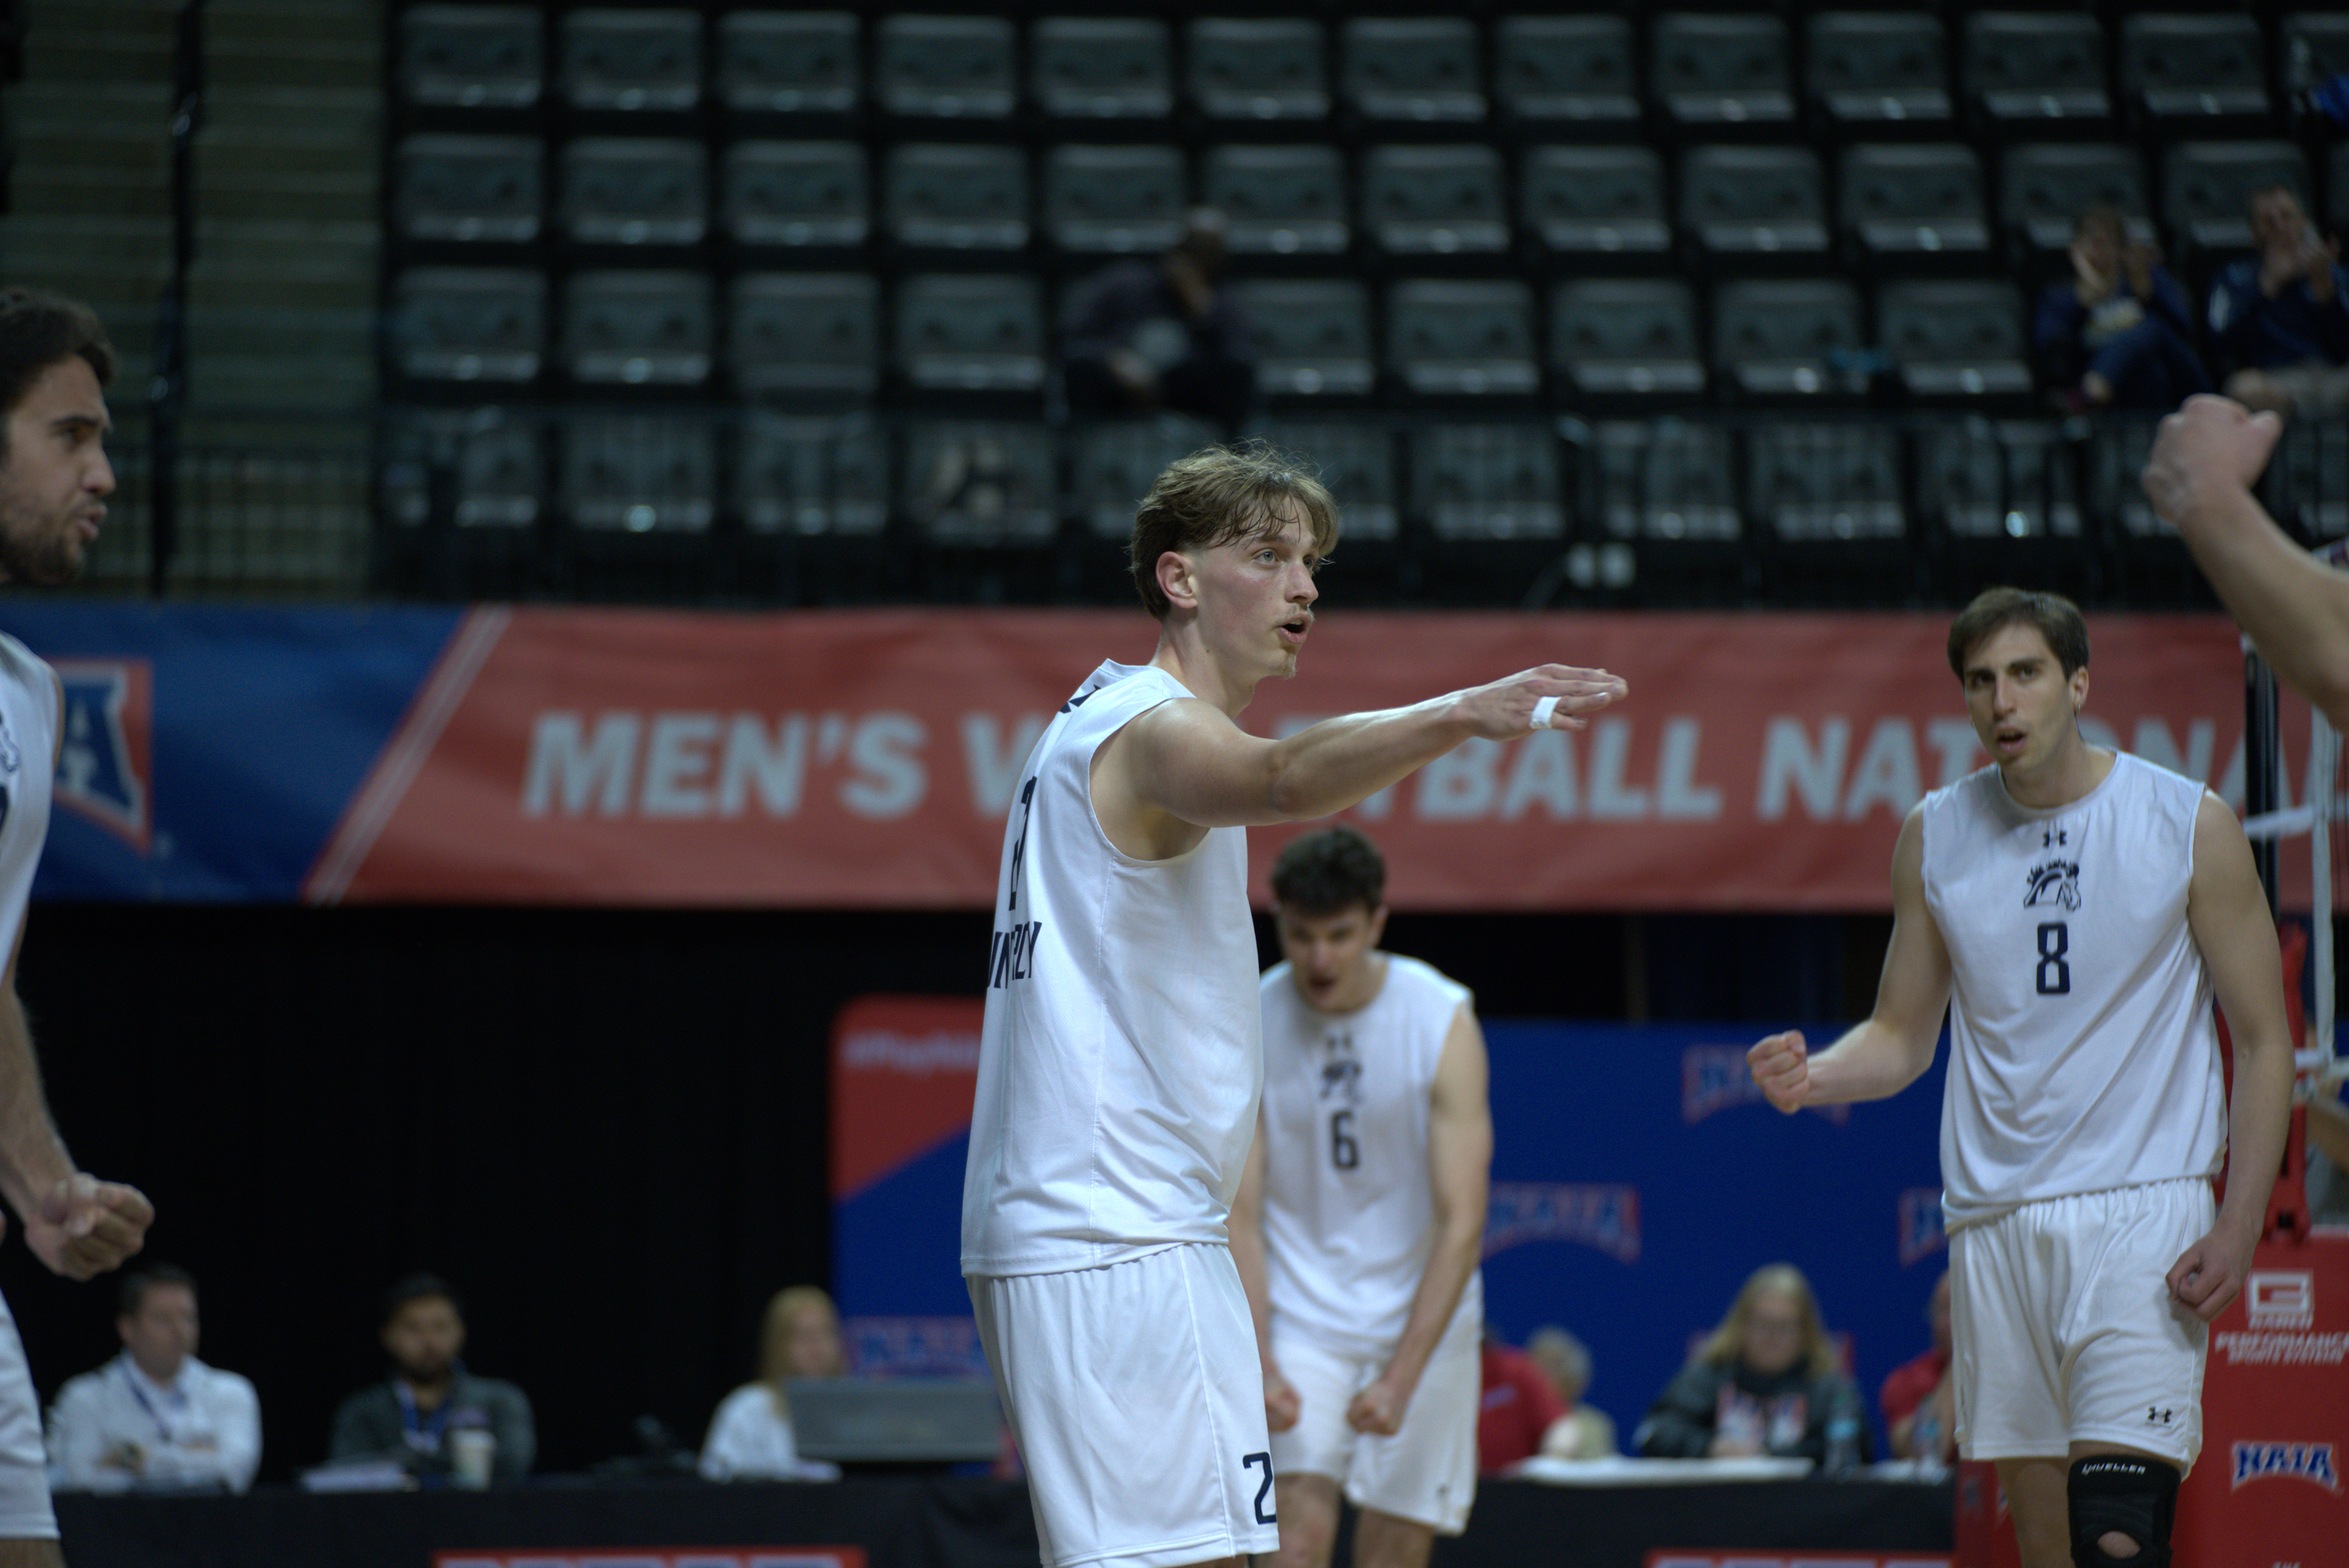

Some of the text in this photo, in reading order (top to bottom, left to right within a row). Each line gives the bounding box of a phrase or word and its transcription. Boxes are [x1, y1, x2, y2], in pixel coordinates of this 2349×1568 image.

[522, 711, 928, 819] MEN'S
[2036, 921, 2071, 995] 8
[1331, 1110, 1359, 1171] 6
[1242, 1451, 1277, 1526] 2
[2081, 1462, 2146, 1477] MUELLER
[2231, 1441, 2338, 1492] NAIA
